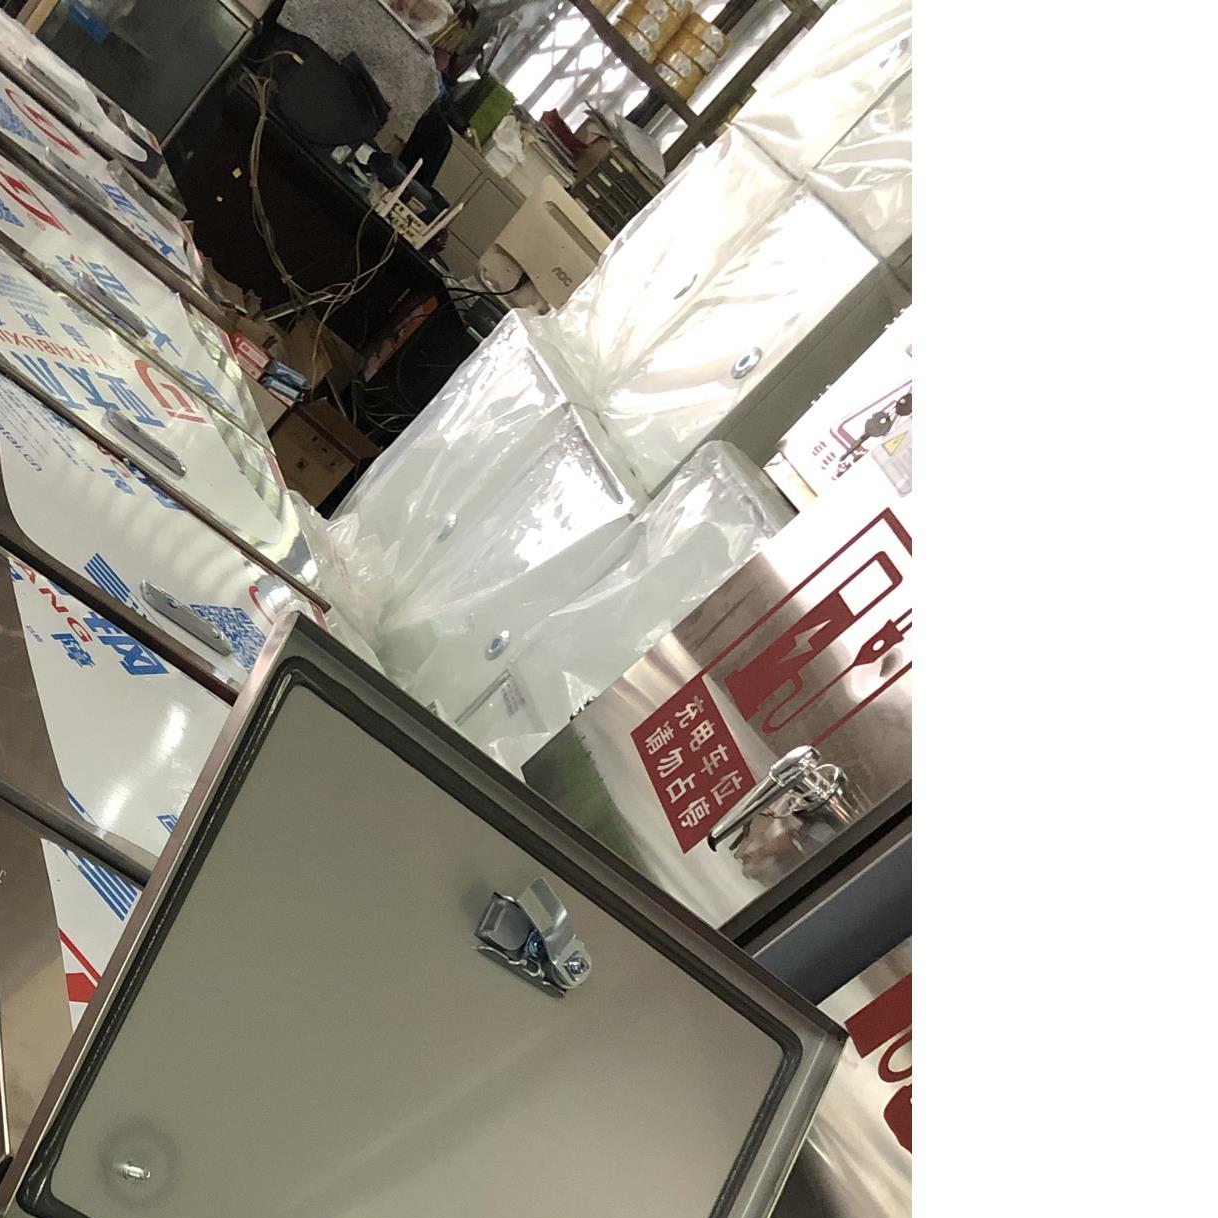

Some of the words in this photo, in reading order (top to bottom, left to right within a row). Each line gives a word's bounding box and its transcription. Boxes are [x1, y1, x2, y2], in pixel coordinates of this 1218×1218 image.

[645, 720, 712, 829] 请勿占停
[674, 695, 743, 806] 充电车位
